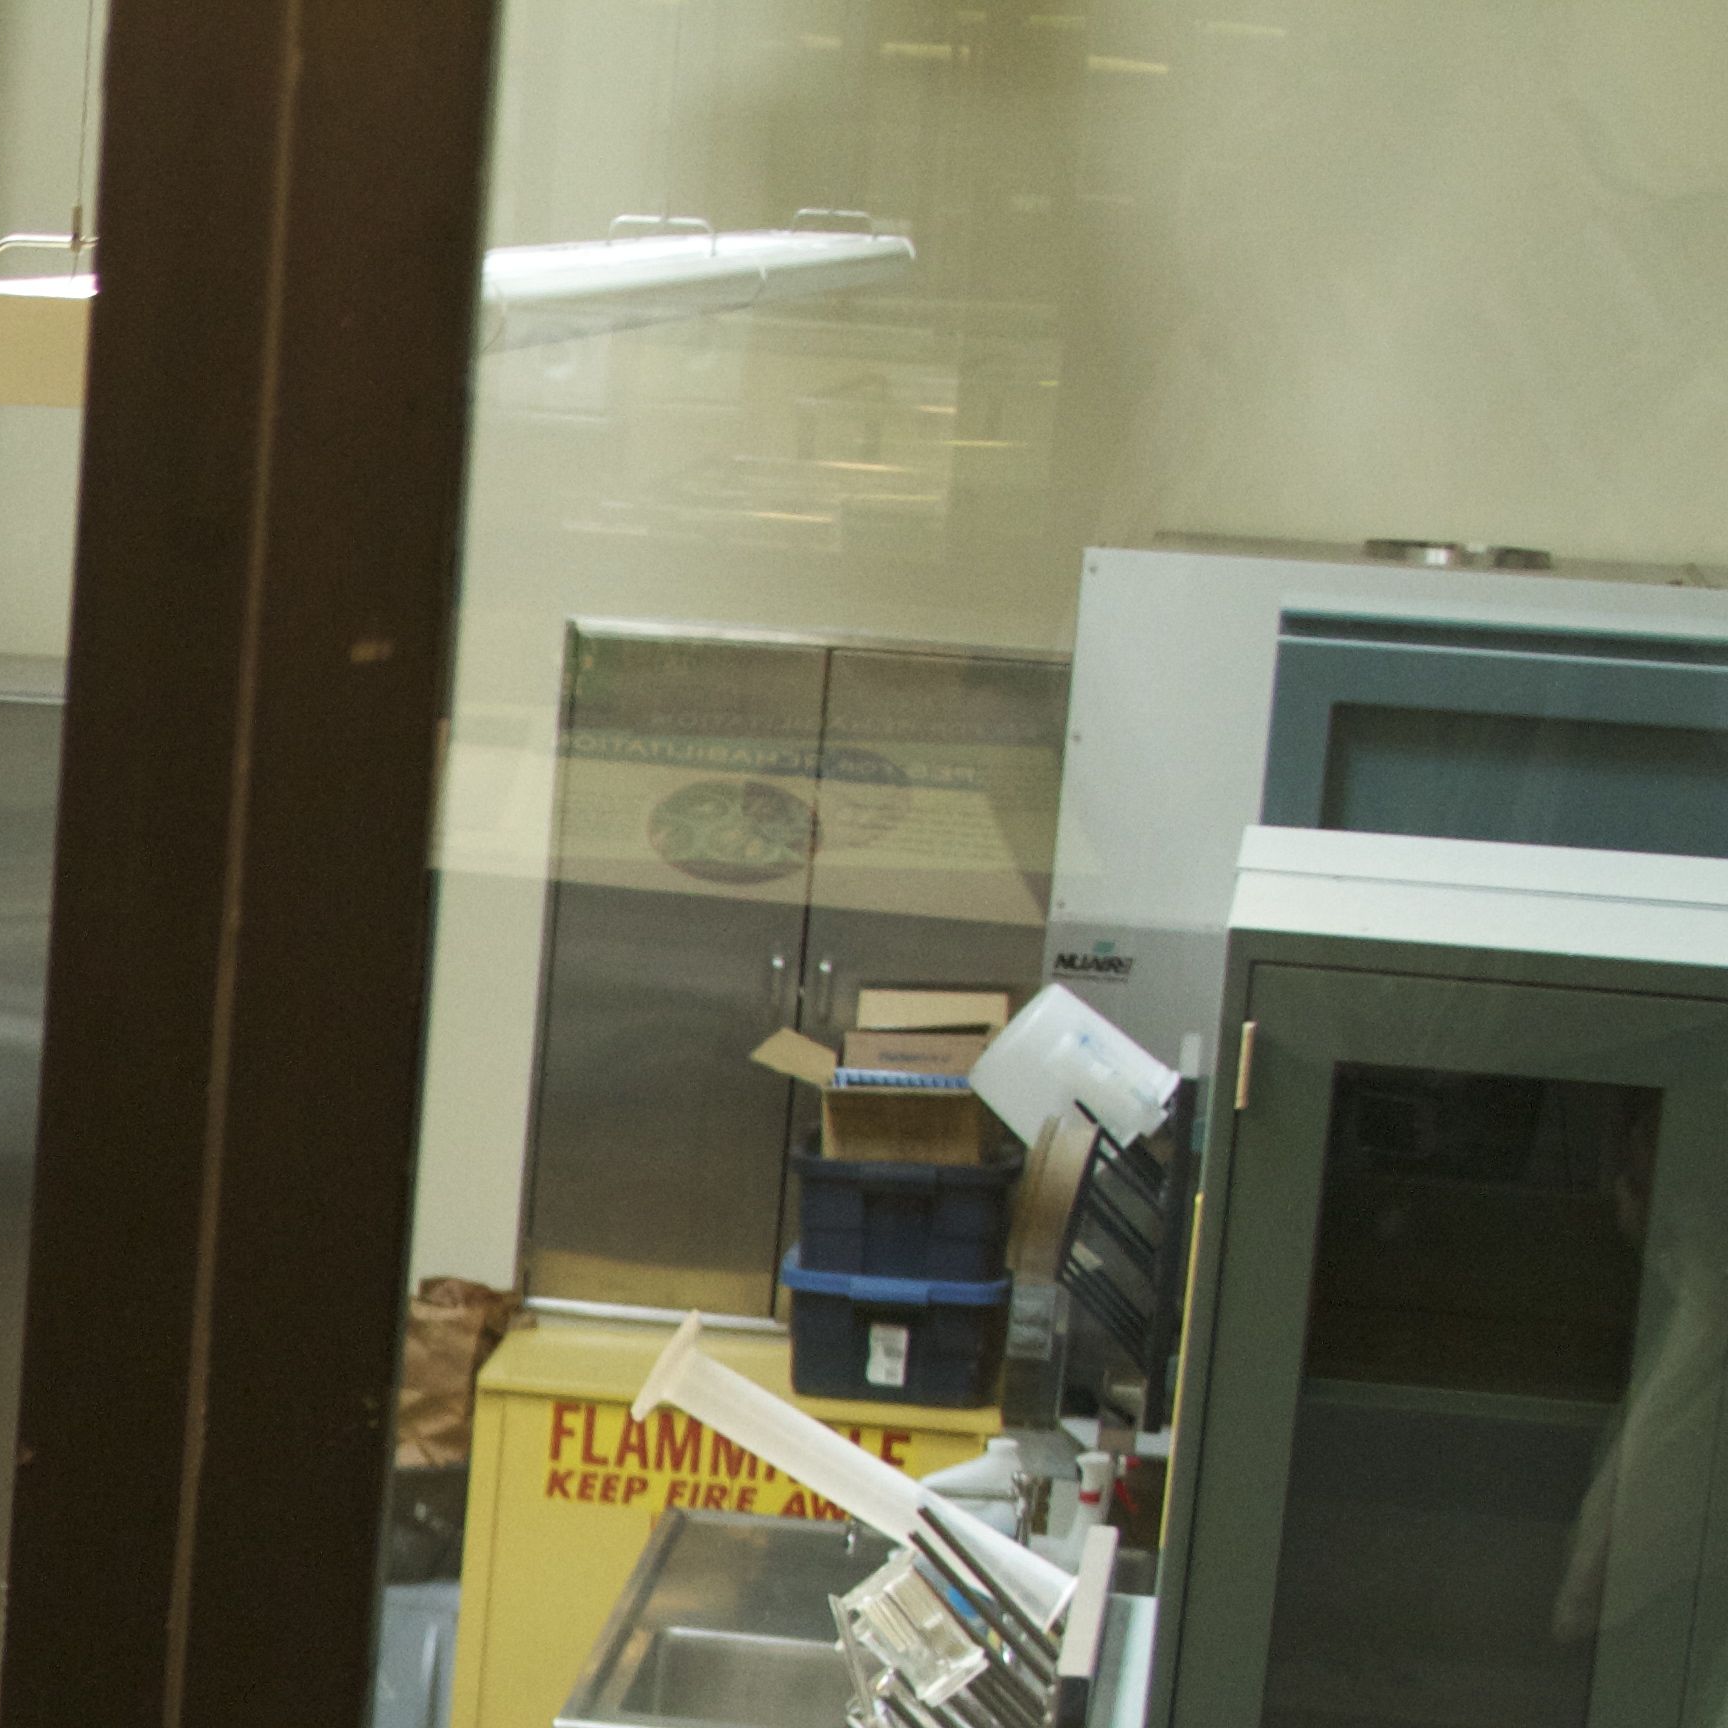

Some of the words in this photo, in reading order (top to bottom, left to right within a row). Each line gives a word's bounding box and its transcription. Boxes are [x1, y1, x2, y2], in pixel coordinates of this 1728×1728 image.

[548, 1402, 912, 1484] FLAMME
[545, 1469, 649, 1506] KEEP
[665, 1480, 758, 1516] FIRE
[781, 1490, 844, 1521] AW
